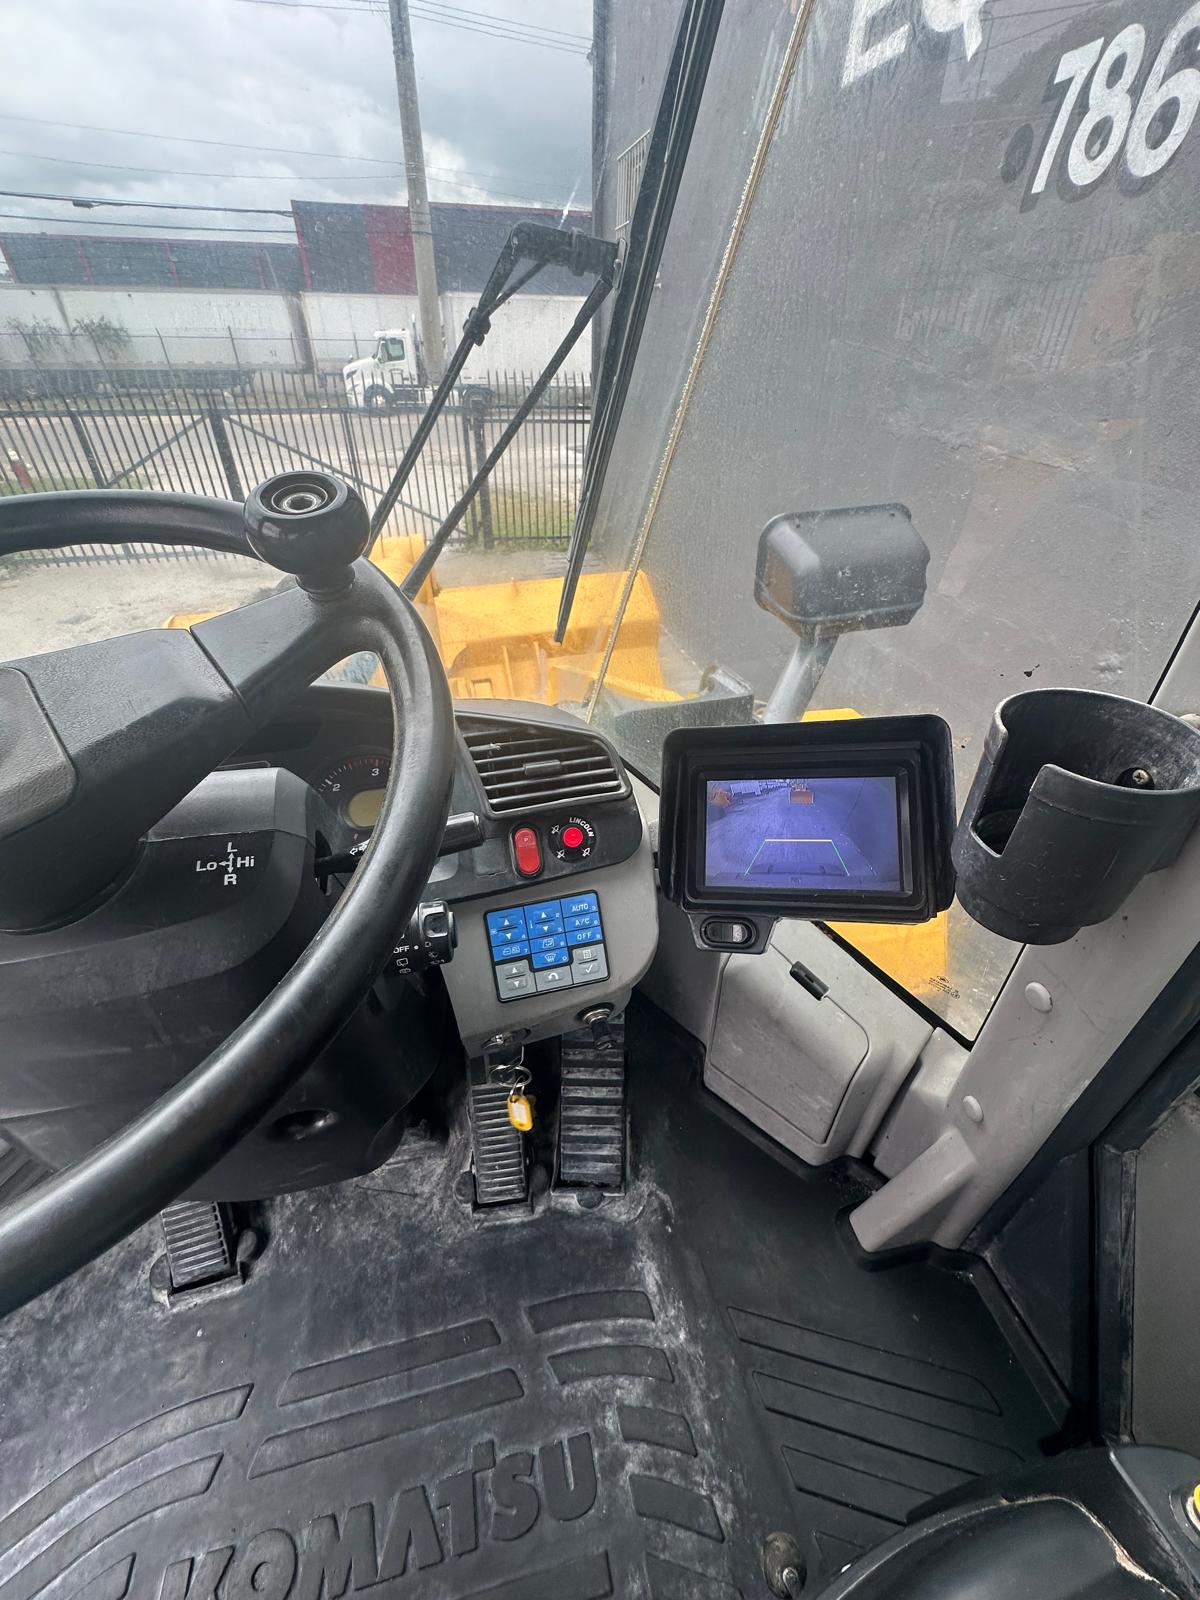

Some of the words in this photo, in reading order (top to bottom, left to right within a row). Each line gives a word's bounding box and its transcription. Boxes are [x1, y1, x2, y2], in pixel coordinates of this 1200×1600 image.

[371, 768, 380, 777] 3
[332, 783, 341, 792] 2
[569, 817, 594, 837] LINCOLN
[227, 842, 238, 852] L
[196, 860, 218, 872] Lo
[236, 855, 255, 868] Hi
[224, 873, 237, 886] R
[571, 903, 589, 912] AUTO
[575, 917, 590, 926] A/C
[577, 932, 593, 941] OFF
[393, 945, 410, 954] OFF
[157, 1432, 598, 1600] KOMATSU
